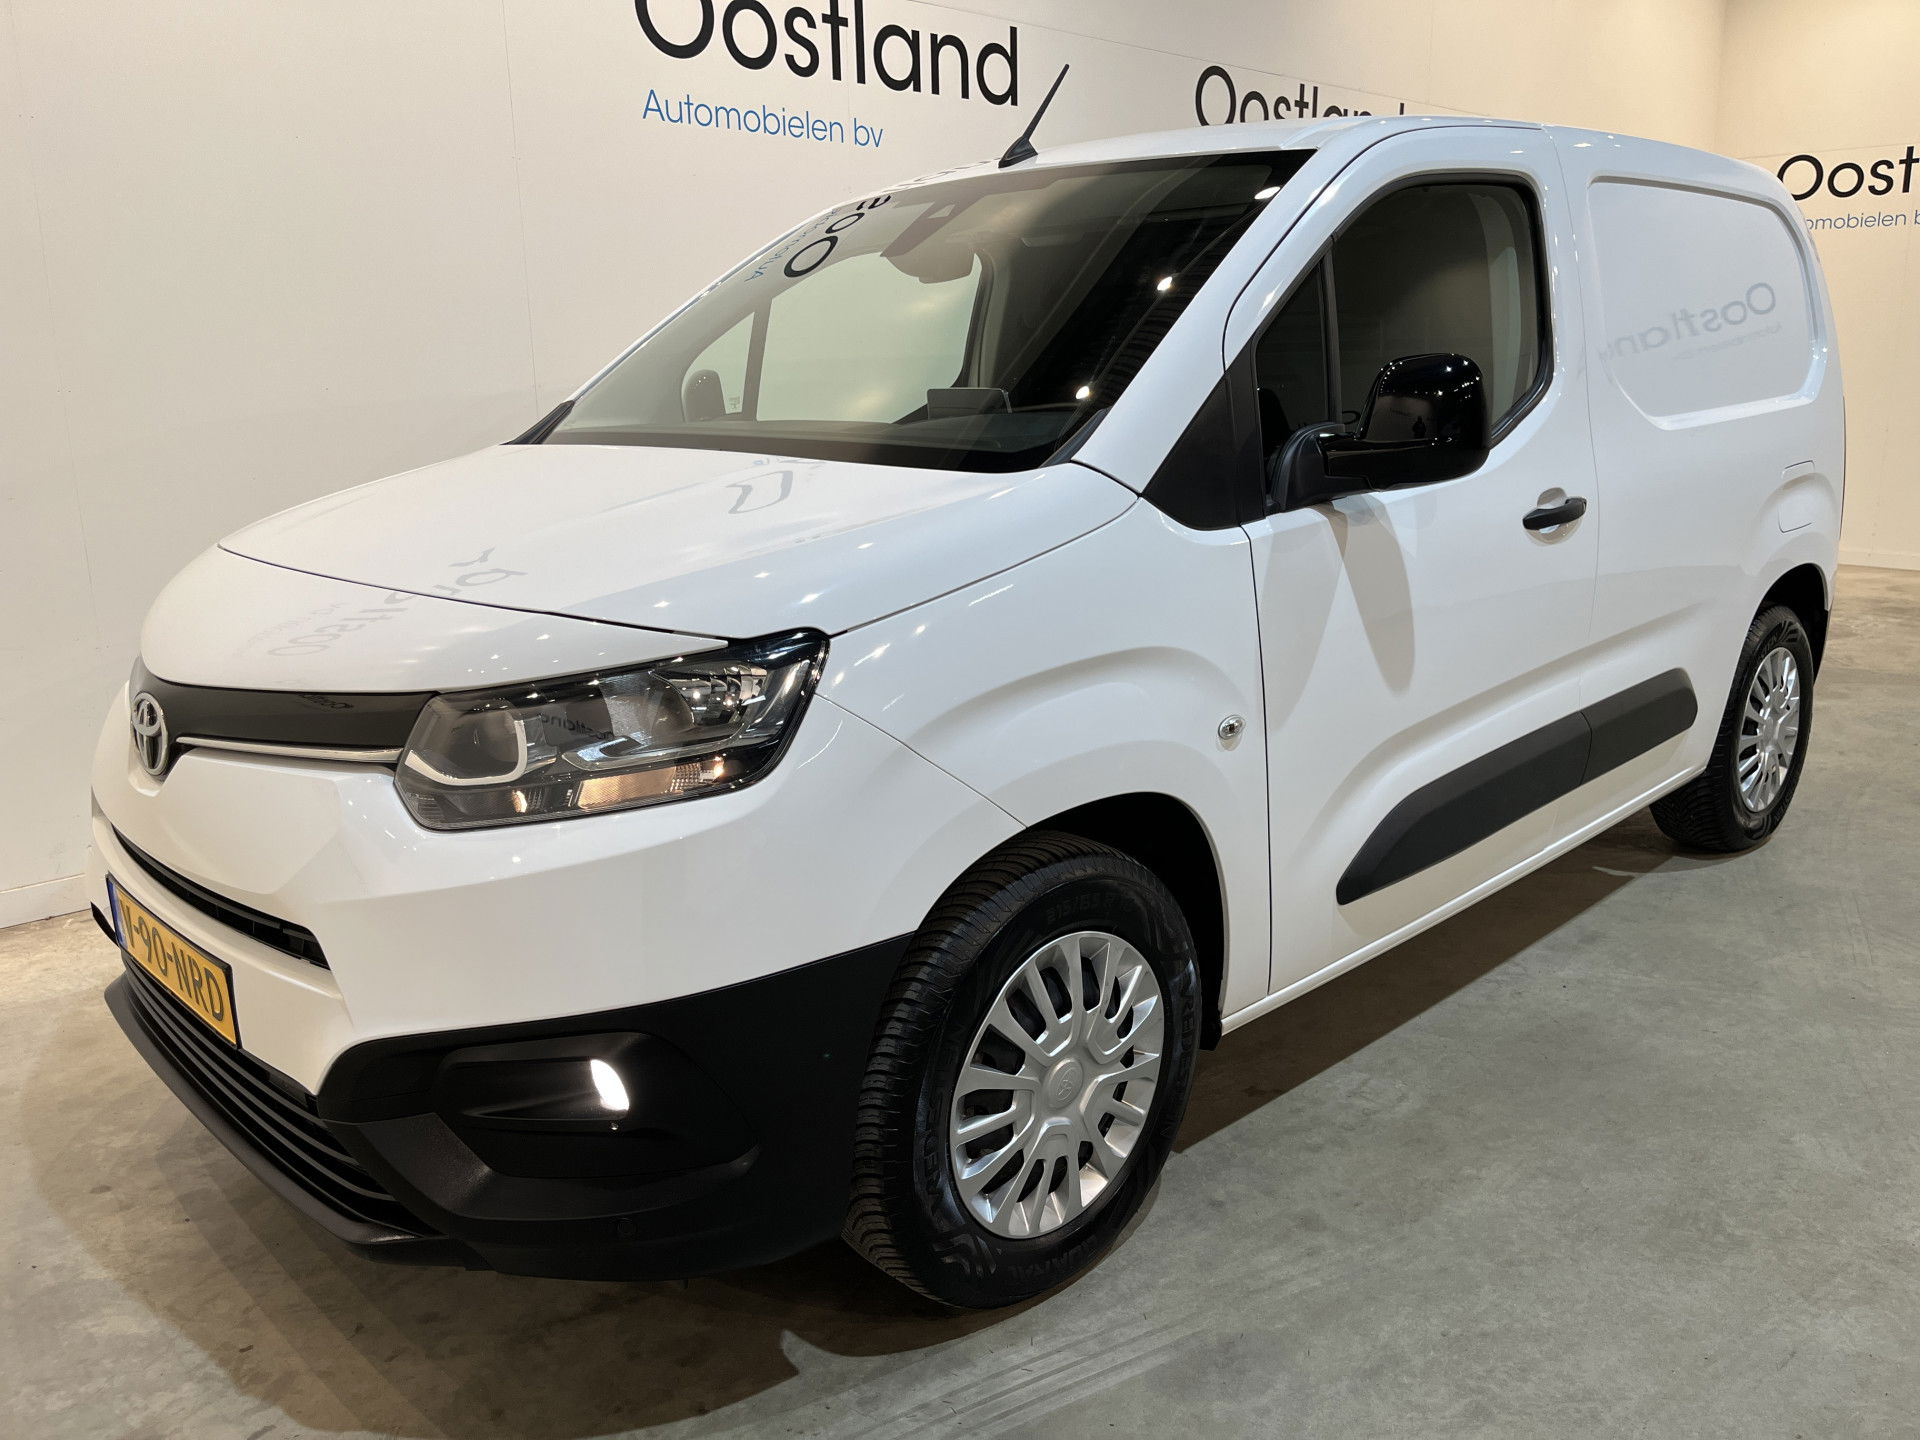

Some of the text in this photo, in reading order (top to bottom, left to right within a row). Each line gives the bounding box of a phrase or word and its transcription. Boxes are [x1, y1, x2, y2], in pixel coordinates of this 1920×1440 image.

[635, 0, 1018, 106] Oostland
[643, 89, 883, 147] Automobielen bv
[120, 899, 224, 1022] V-90-NRD
